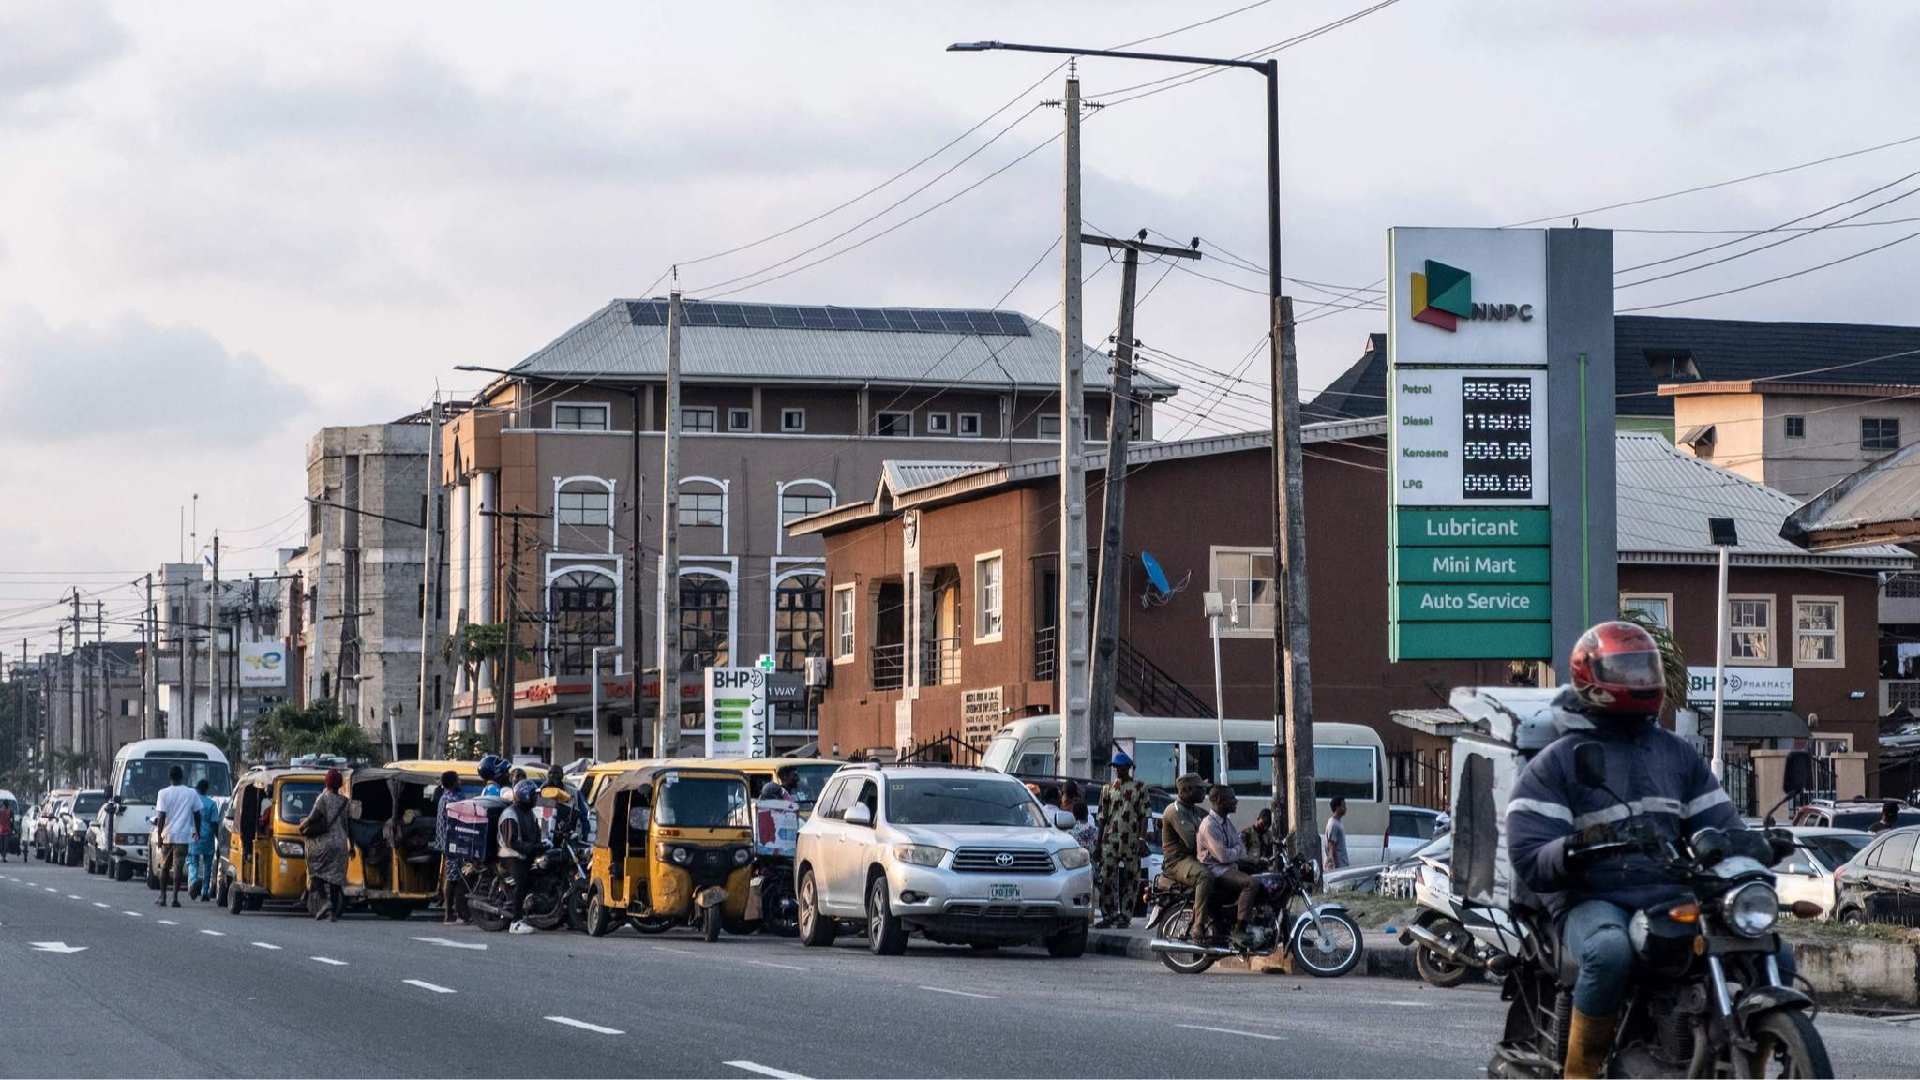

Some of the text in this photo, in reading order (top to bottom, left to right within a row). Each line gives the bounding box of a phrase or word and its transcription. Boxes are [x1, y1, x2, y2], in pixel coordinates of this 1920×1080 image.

[1471, 302, 1533, 322] NNPC
[1402, 383, 1432, 394] Petrol
[1402, 415, 1433, 426] Diesel
[1402, 447, 1449, 458] Kerosene
[1402, 479, 1423, 489] LPG
[1426, 518, 1519, 536] Lubricant
[1432, 556, 1517, 573] Mini Mart
[1420, 592, 1530, 609] Auto Service
[713, 671, 750, 689] BHP
[1743, 680, 1792, 690] PHARMACY
[774, 686, 797, 696] WAY
[751, 693, 764, 758] RMACY
